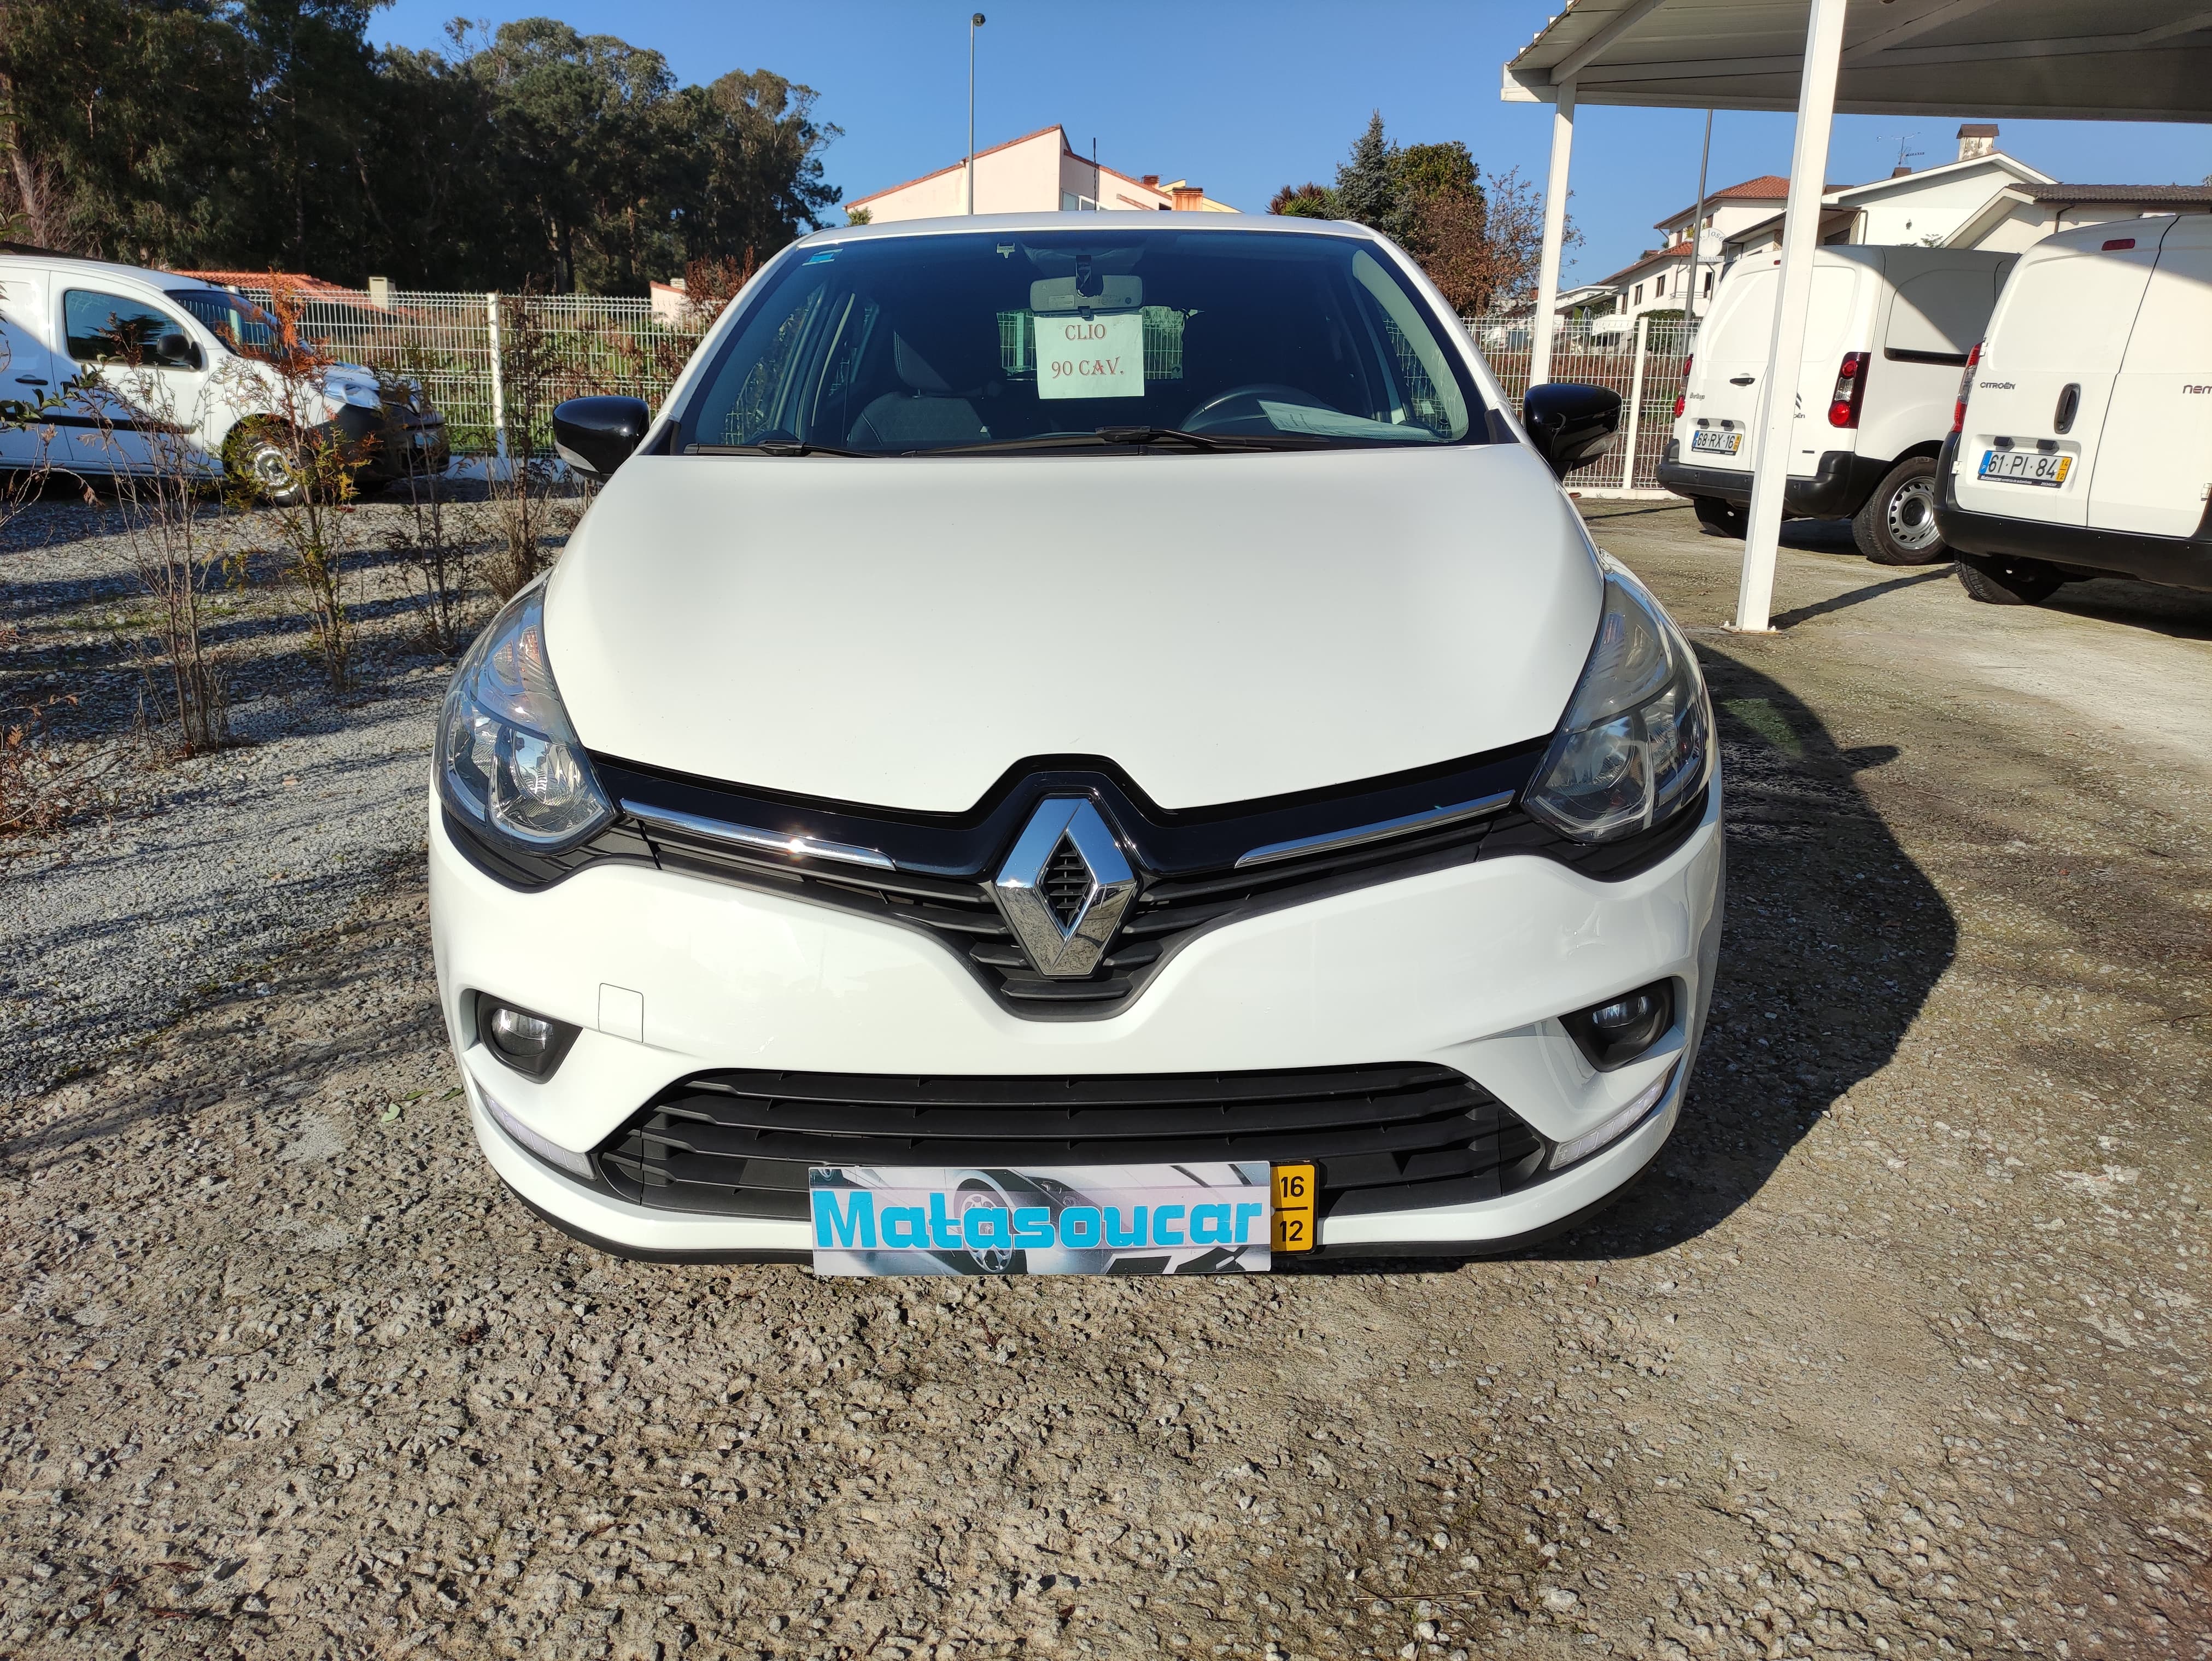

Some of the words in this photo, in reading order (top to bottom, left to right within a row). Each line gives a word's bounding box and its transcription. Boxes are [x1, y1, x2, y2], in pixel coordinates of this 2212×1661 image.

[1064, 324, 1107, 341] CLIO
[1051, 361, 1073, 379] 90
[1079, 356, 1125, 376] CAV.
[1980, 382, 2016, 390] CITROËN
[1281, 1176, 1304, 1198] 16
[813, 1190, 1262, 1250] Matasoucar
[1280, 1220, 1303, 1242] 12
